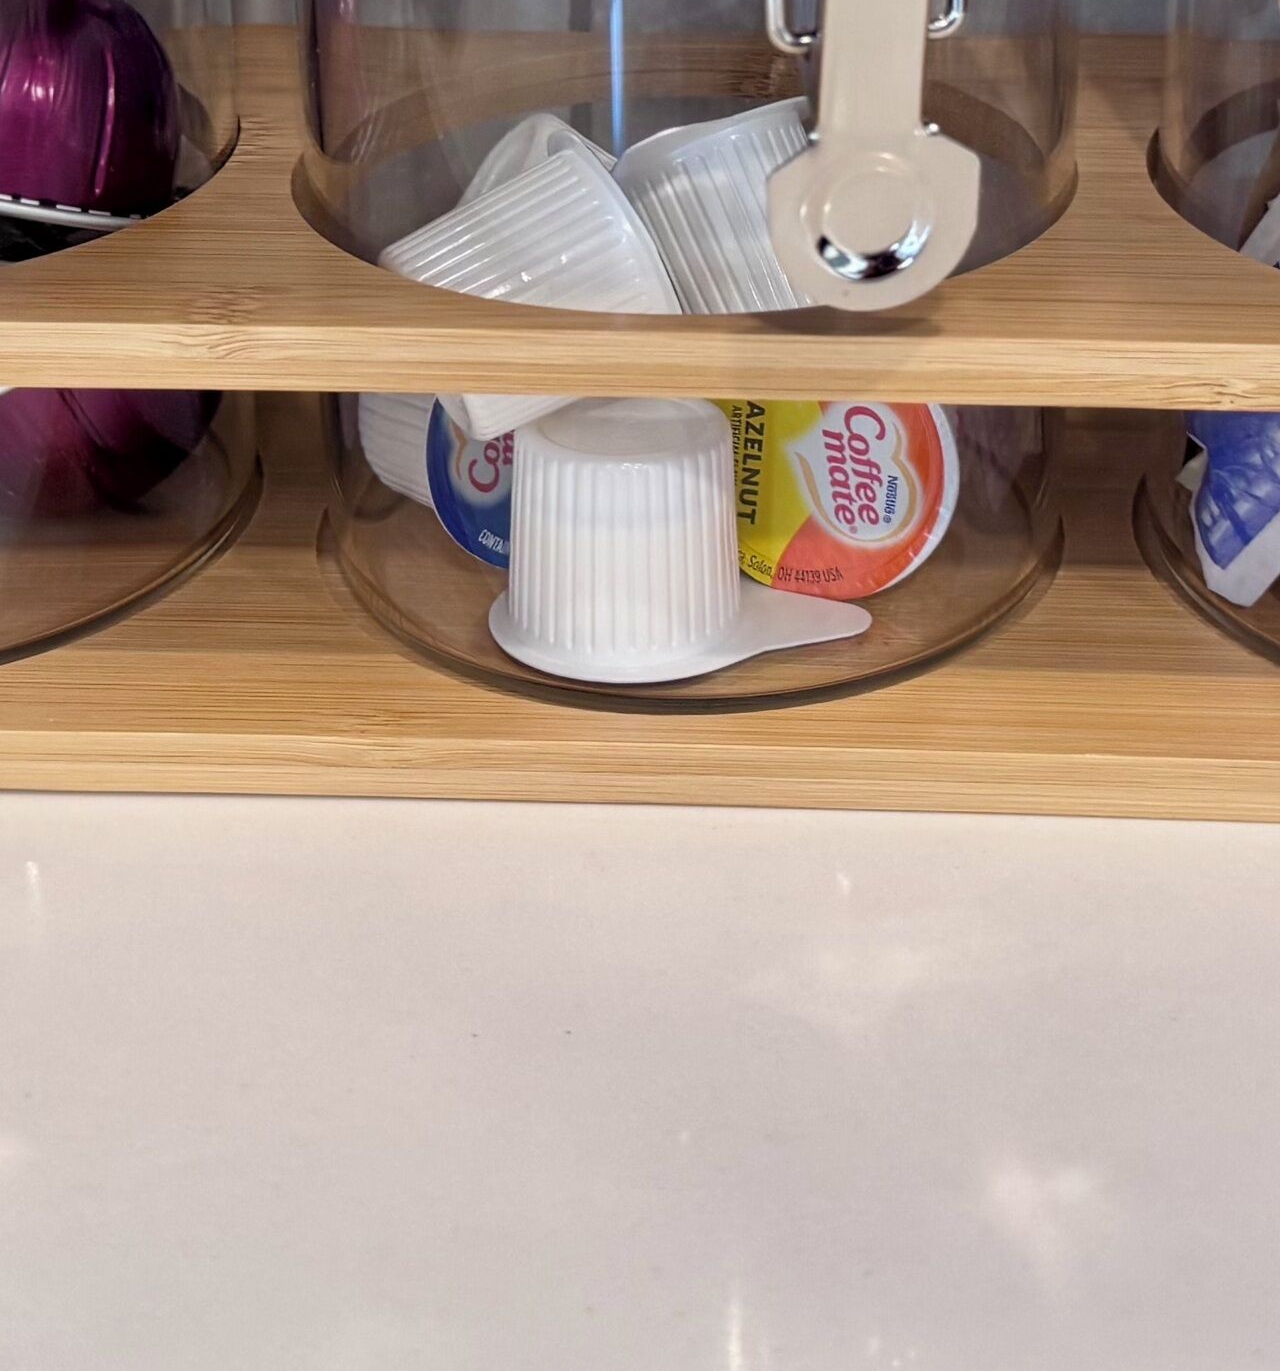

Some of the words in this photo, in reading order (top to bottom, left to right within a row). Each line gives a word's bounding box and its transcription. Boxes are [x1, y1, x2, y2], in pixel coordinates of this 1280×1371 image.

[737, 401, 766, 525] AZELNUT
[823, 429, 857, 525] mate
[844, 405, 886, 526] Coffee
[478, 528, 511, 554] CONTA
[777, 566, 793, 582] OH
[794, 569, 822, 584] 44139
[823, 566, 845, 583] USA
